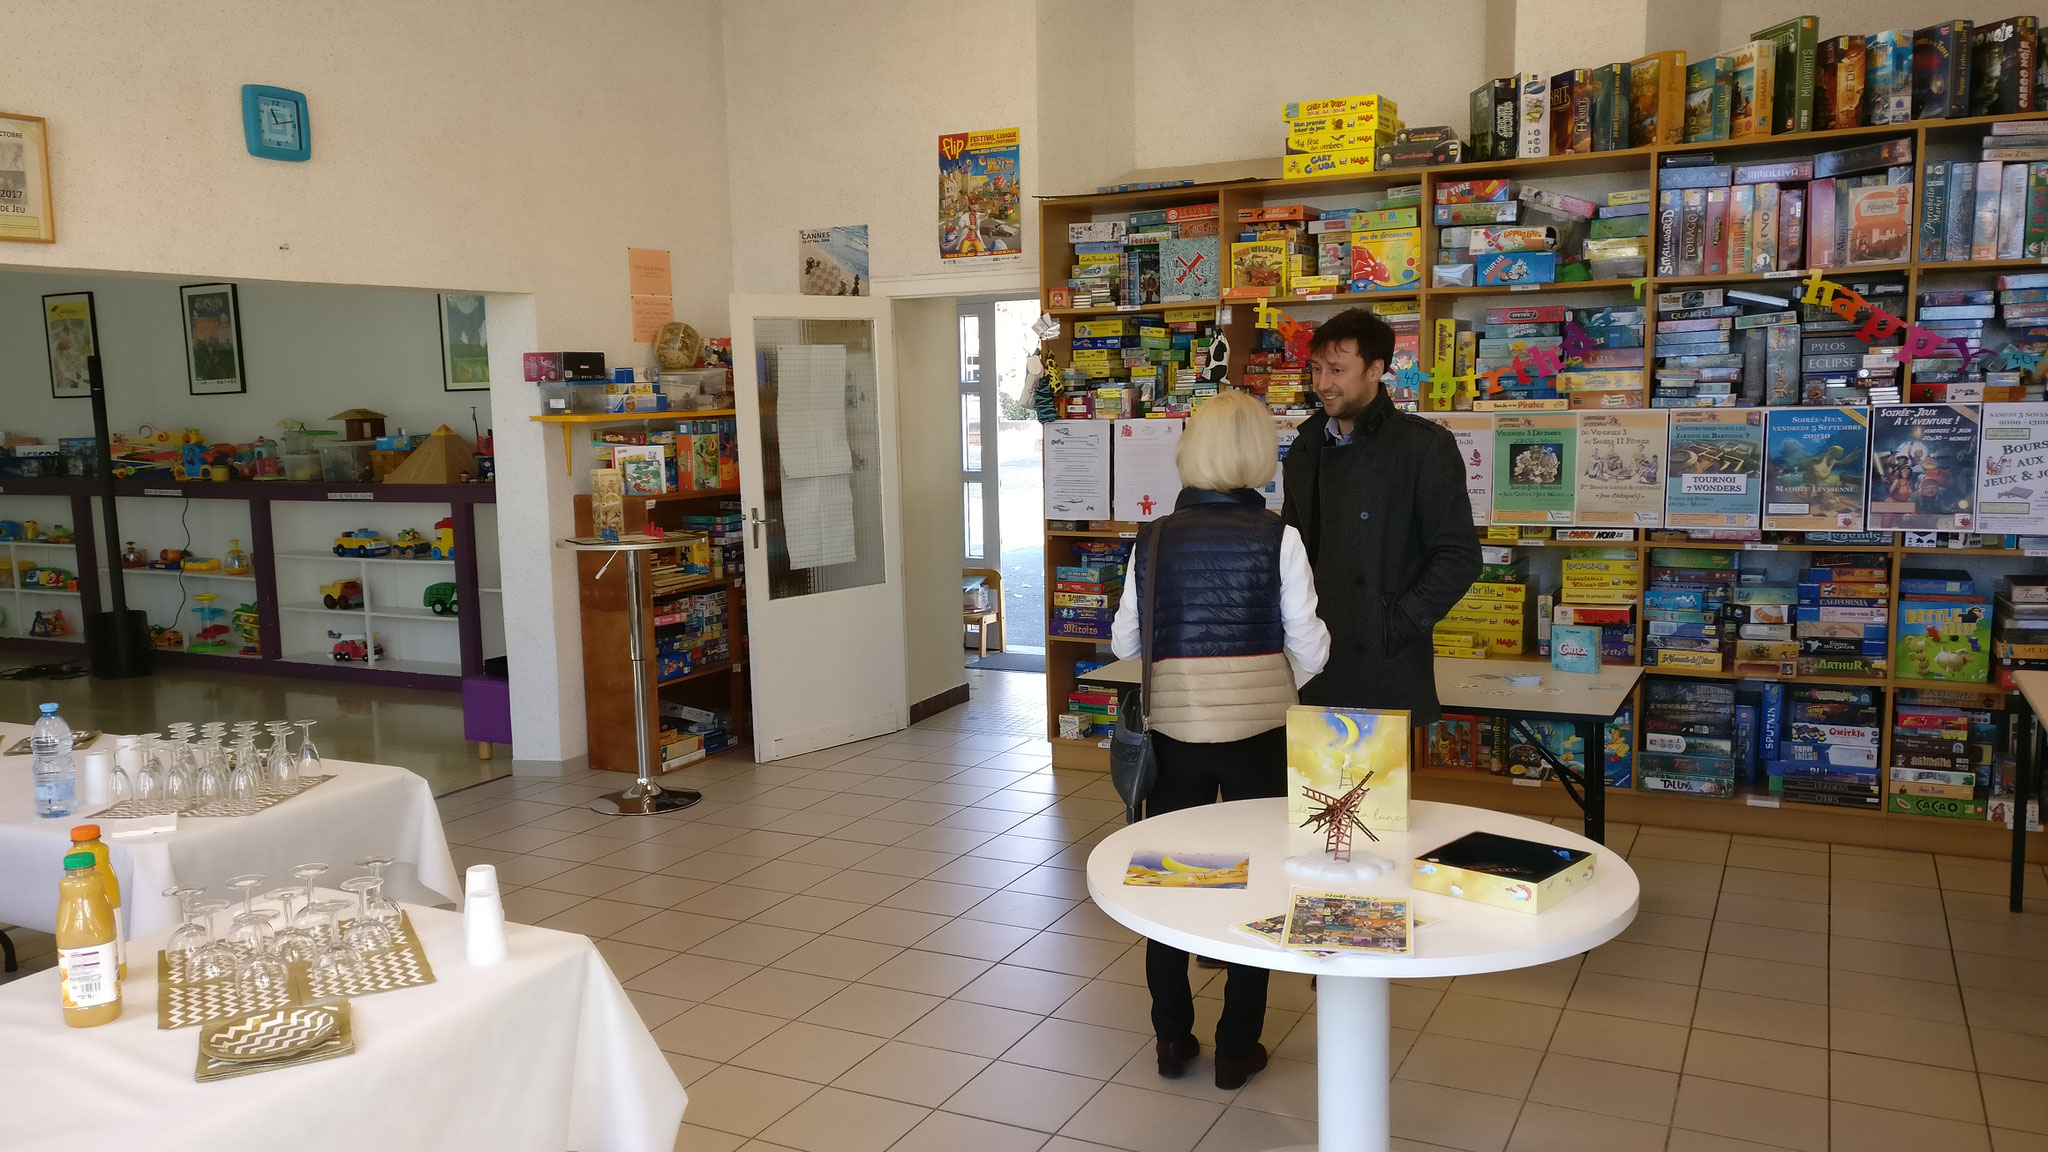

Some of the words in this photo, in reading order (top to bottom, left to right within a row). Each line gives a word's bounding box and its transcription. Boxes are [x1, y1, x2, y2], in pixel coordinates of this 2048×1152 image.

[2018, 39, 2031, 69] NOIR
[1800, 49, 1813, 97] MEGAWATTS
[2018, 69, 2031, 108] CARGO
[1306, 102, 1322, 111] CHEF
[1330, 100, 1347, 108] TRIBU
[1359, 100, 1375, 108] HABA
[1306, 119, 1327, 128] premier
[1358, 114, 1374, 123] HABA
[1315, 125, 1326, 133] jeux
[970, 134, 995, 143] FESTIVAL
[996, 131, 1017, 140] LUDIQUE
[1306, 137, 1320, 146] fête
[1356, 135, 1372, 144] HABA
[1320, 142, 1344, 151] ombres
[1311, 154, 1332, 164] GARY
[1350, 156, 1369, 165] HABA
[1304, 162, 1336, 174] GOUDA
[1748, 167, 1799, 180] HIMALAYA
[1, 189, 23, 199] 2017
[1450, 182, 1471, 196] TIME
[1924, 186, 1936, 235] Portobello
[1933, 195, 1944, 224] Market
[802, 231, 830, 240] CANNES
[1359, 234, 1370, 242] jeu
[1380, 231, 1413, 239] dinosaures
[1684, 213, 1698, 260] TOBAGO
[1250, 245, 1284, 254] WILDLIFE
[1483, 260, 1500, 277] SALUT
[1494, 254, 1506, 265] LES
[1811, 342, 1846, 352] PYLOS
[1808, 357, 1857, 369] ECLIPSE
[2012, 353, 2033, 364] 40
[1404, 371, 1420, 386] 40
[1518, 401, 1545, 409] Pirates
[1880, 407, 1938, 418] SOIRÉE-JEUX
[1903, 417, 1953, 426] L'AVENTURE
[1622, 428, 1627, 436] 3
[1811, 425, 1817, 433] 5
[2017, 455, 2045, 468] AUX
[1983, 474, 2018, 488] JEUX
[2021, 470, 2034, 481] &
[1693, 484, 1742, 492] WONDERS
[1595, 530, 1617, 540] NOIR
[1819, 598, 1868, 607] CALIFORNIA
[1905, 607, 1963, 624] BATTLE
[1503, 618, 1520, 626] HABA
[1063, 623, 1099, 635] Miroirs
[1496, 637, 1518, 648] HABA
[1818, 659, 1863, 671] ARTHUR
[1765, 707, 1776, 749] SPUTNIK
[1829, 727, 1865, 738] Qwirkle
[1915, 799, 1959, 813] CACAO
